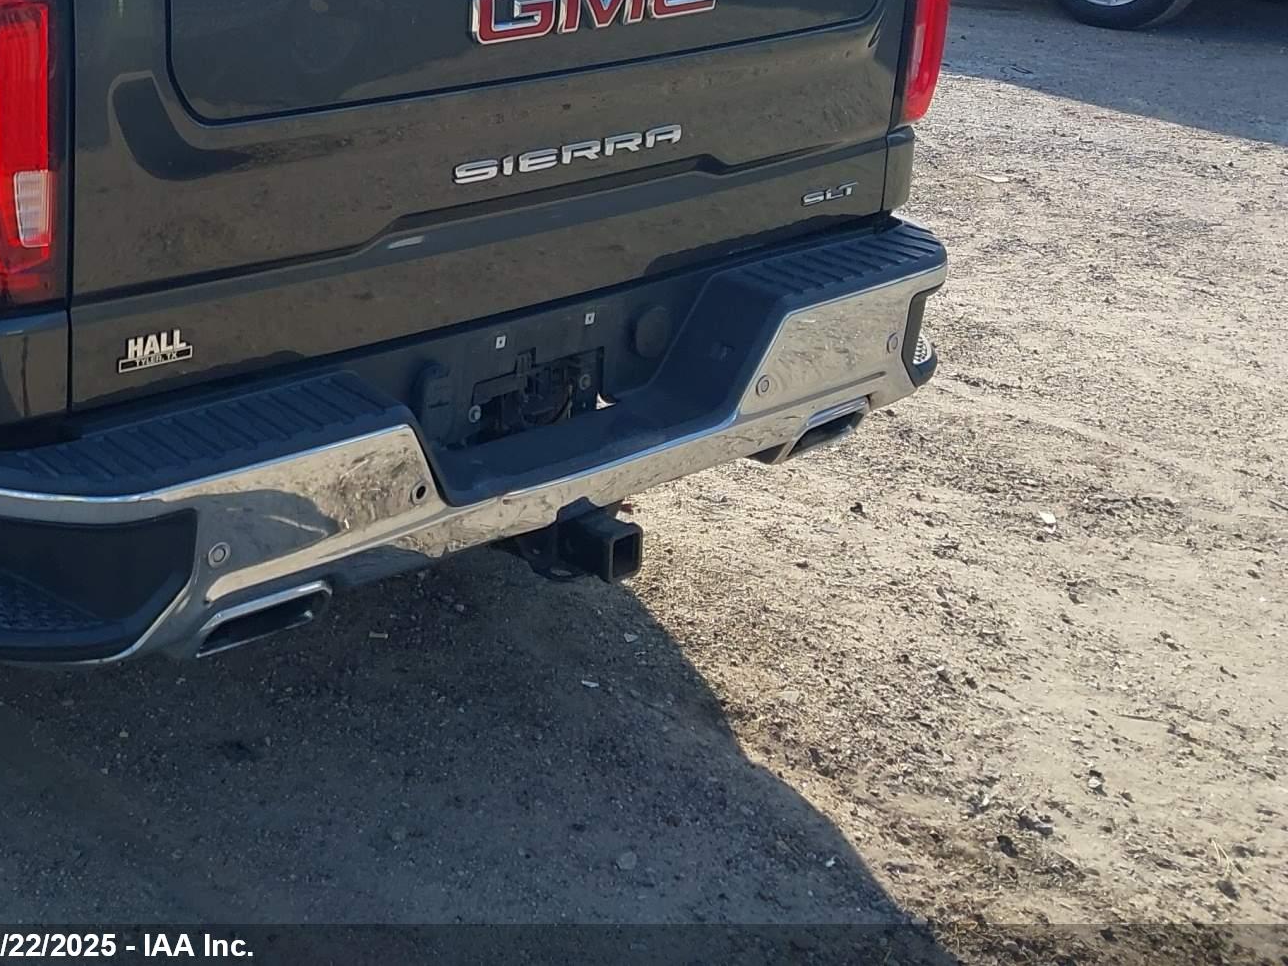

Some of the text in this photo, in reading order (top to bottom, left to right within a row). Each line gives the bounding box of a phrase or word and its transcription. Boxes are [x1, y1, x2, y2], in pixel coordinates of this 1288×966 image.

[452, 123, 682, 184] SIERRA
[801, 181, 858, 206] SLT
[127, 329, 187, 360] HALL
